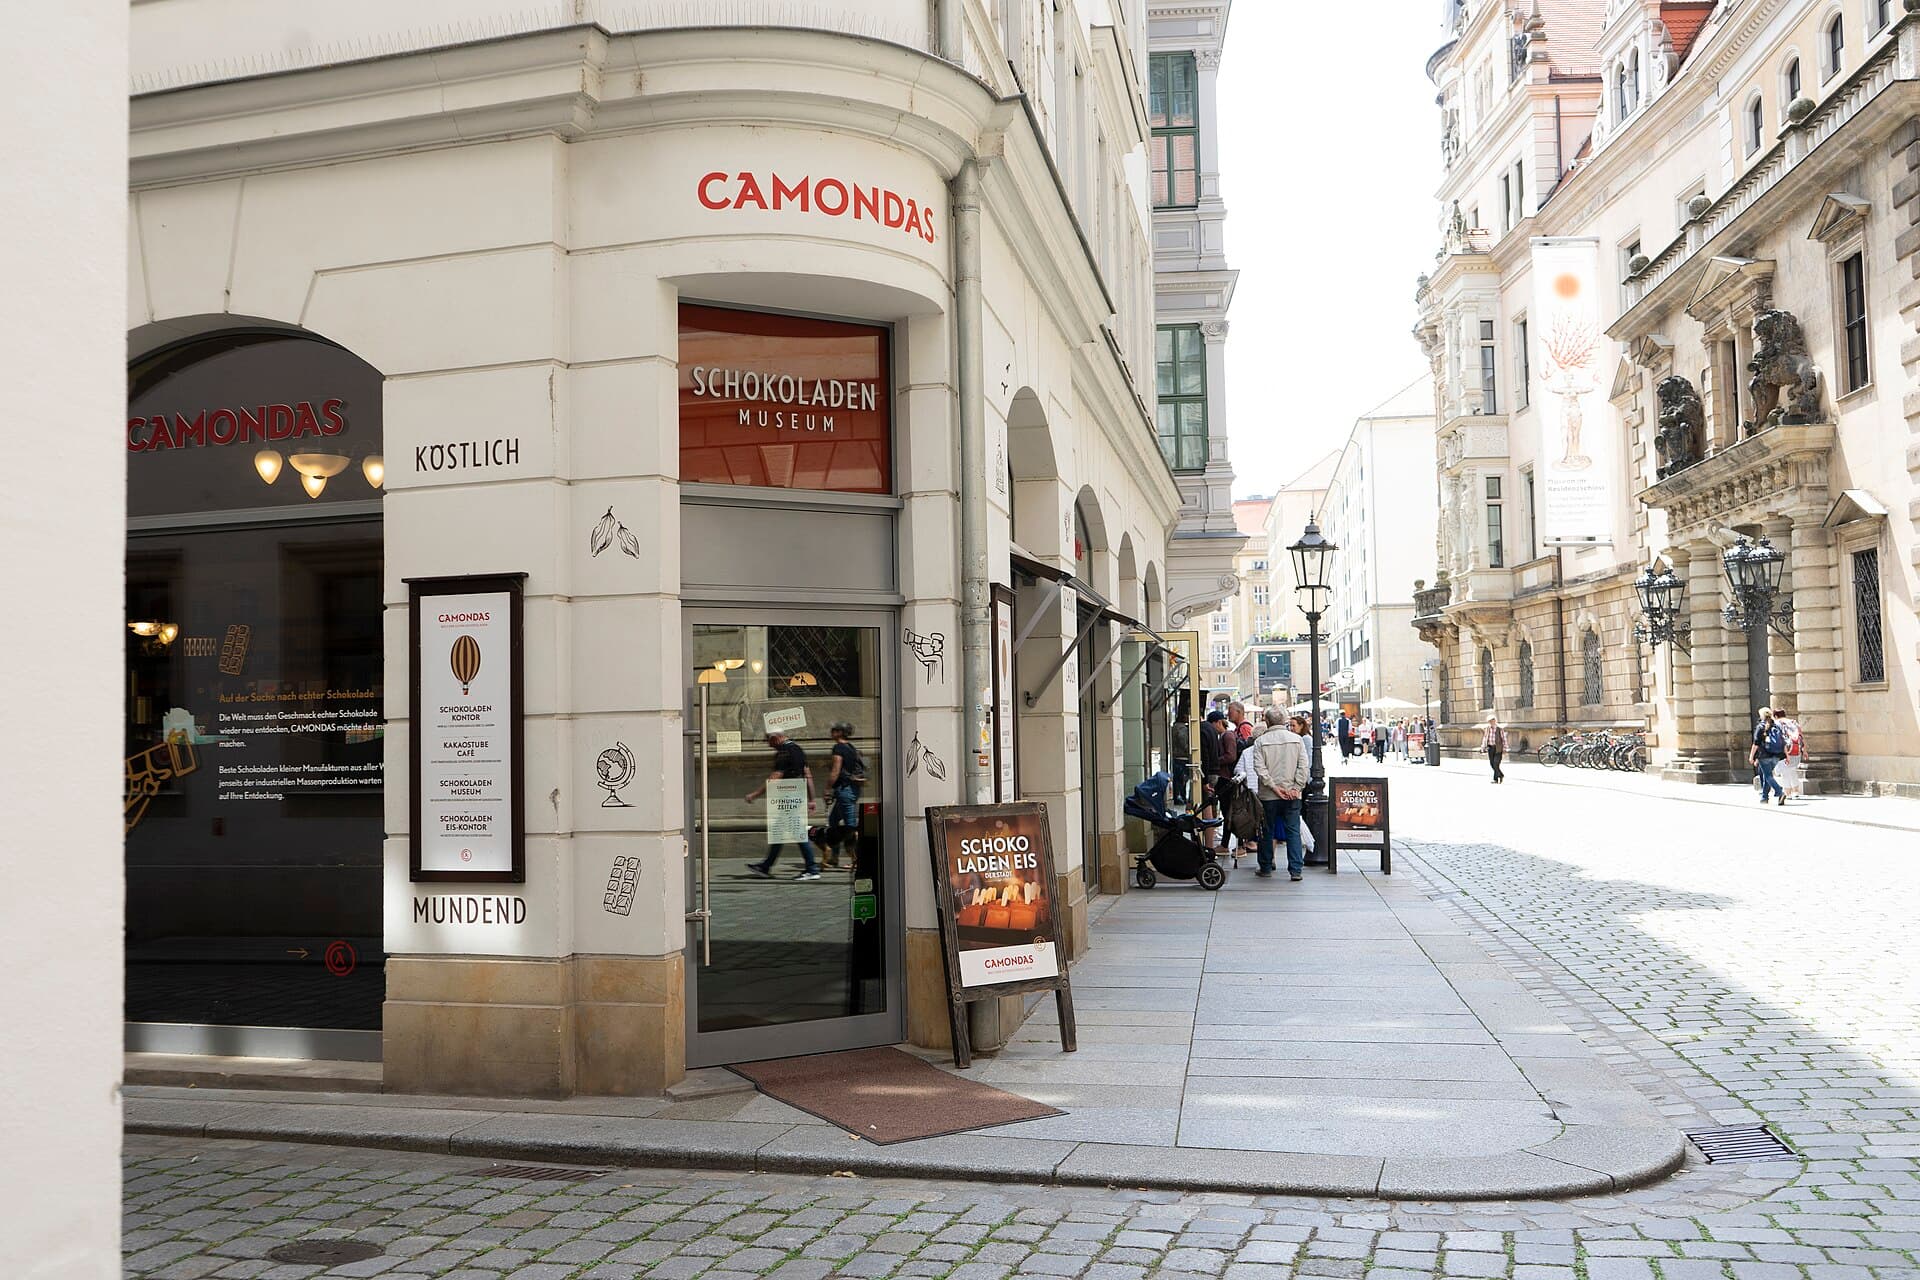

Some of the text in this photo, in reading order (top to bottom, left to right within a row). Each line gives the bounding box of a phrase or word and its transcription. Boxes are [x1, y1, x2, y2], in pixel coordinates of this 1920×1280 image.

[698, 172, 935, 243] CAMONDAS
[693, 366, 876, 411] SCHOKOLADEN
[127, 399, 344, 452] CAMONDAS
[739, 409, 835, 432] MUSEUM
[416, 438, 519, 472] KÖSTLICH
[438, 612, 490, 623] CAMONDAS
[219, 689, 375, 703] Auf der Suche nach echter Schokolade
[219, 713, 231, 721] Die
[231, 712, 247, 721] Welt
[264, 712, 277, 720] den
[278, 711, 316, 720] Geschmack
[317, 710, 338, 719] echter
[339, 708, 378, 718] Schokolade
[440, 705, 492, 713] SCHOKOLADEN
[219, 726, 241, 734] wieder
[255, 725, 290, 734] entdecken,
[291, 723, 336, 733] CAMONDAS
[337, 722, 362, 731] möchte
[363, 722, 375, 731] das
[219, 740, 247, 748] machen.
[443, 741, 489, 749] KAKAOSTUBE
[457, 749, 475, 757] CAFÉ
[219, 765, 237, 774] Beste
[237, 764, 278, 773] Schokoladen
[279, 764, 302, 773] kleiner
[302, 763, 350, 772] Manufakturen
[363, 762, 378, 771] aller
[218, 776, 382, 789] jenseits der industriellen Massenproduktion warten
[440, 779, 492, 787] SCHOKOLADEN
[219, 791, 285, 801] auf Ihre Entdeckung.
[961, 836, 1029, 855] SCHOKO
[957, 852, 1037, 874] LADEN EIS
[414, 897, 526, 924] MUNDEND
[984, 954, 1034, 969] CAMONDAS
